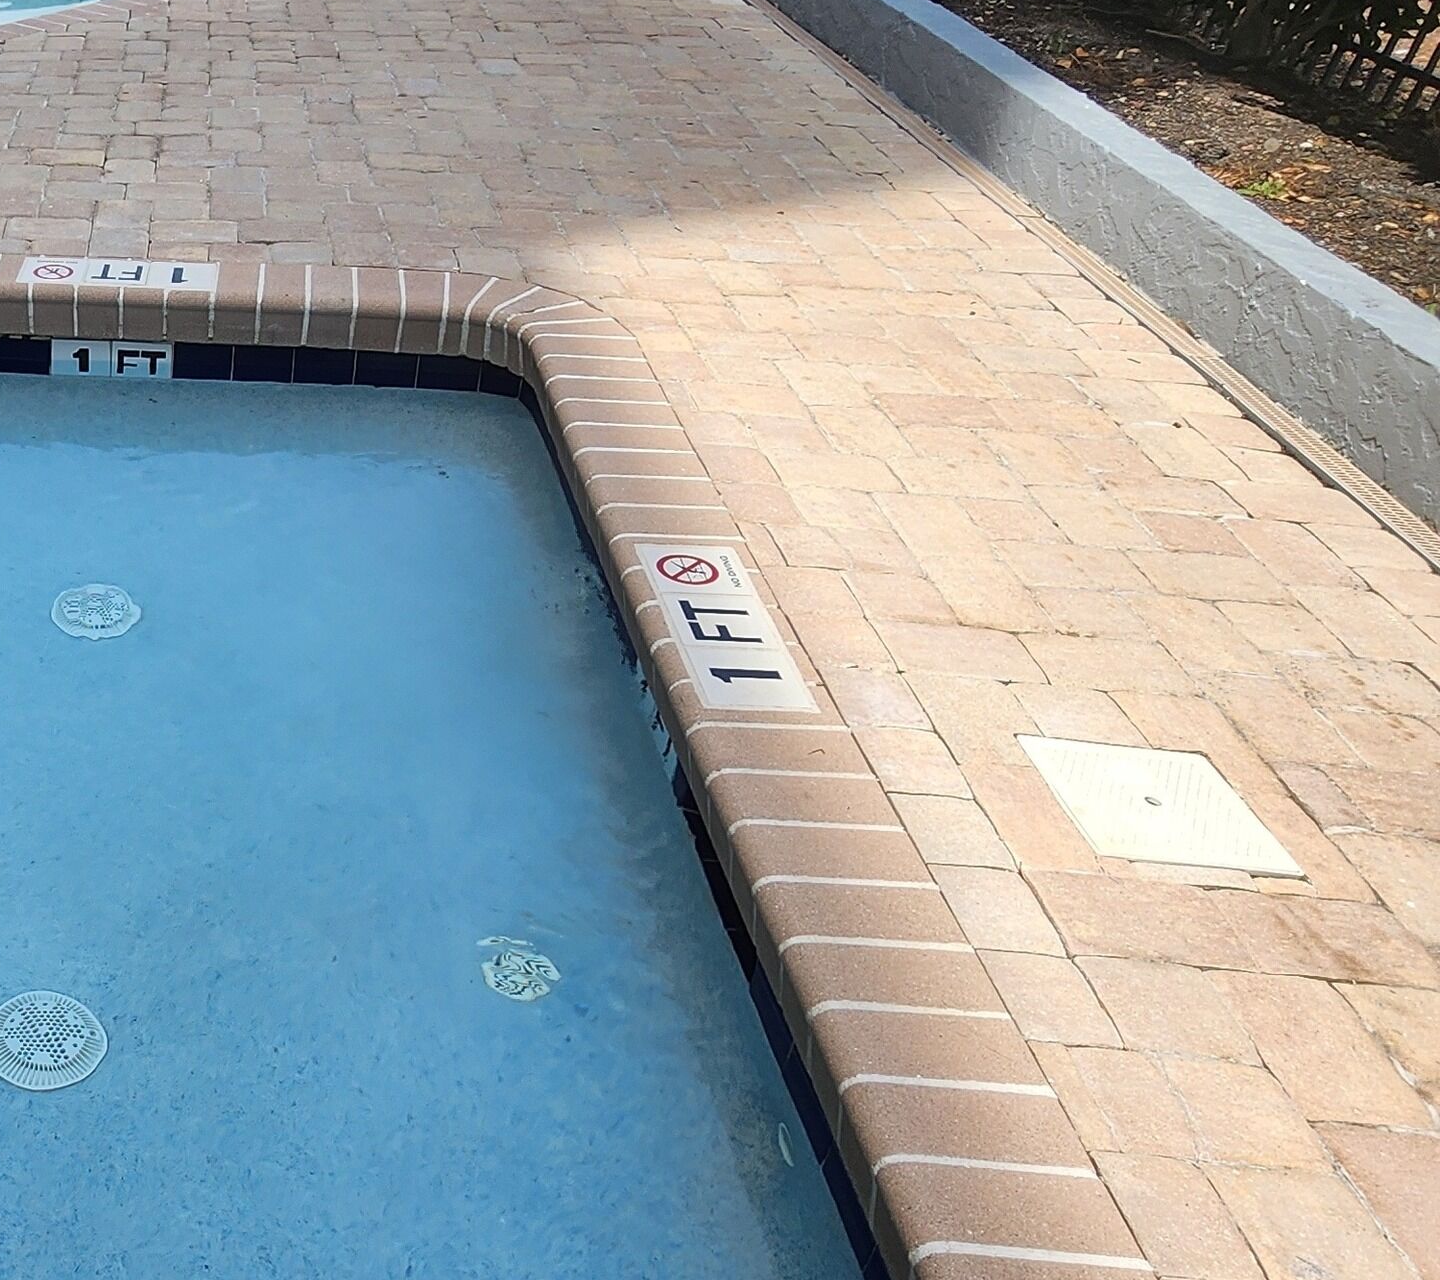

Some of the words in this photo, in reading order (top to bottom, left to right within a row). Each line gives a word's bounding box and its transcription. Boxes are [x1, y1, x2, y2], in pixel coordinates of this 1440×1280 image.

[91, 263, 144, 281] FT
[172, 267, 189, 283] 1
[72, 348, 90, 373] 1
[116, 350, 167, 375] FT
[678, 599, 765, 643] FT
[709, 667, 782, 683] 1
